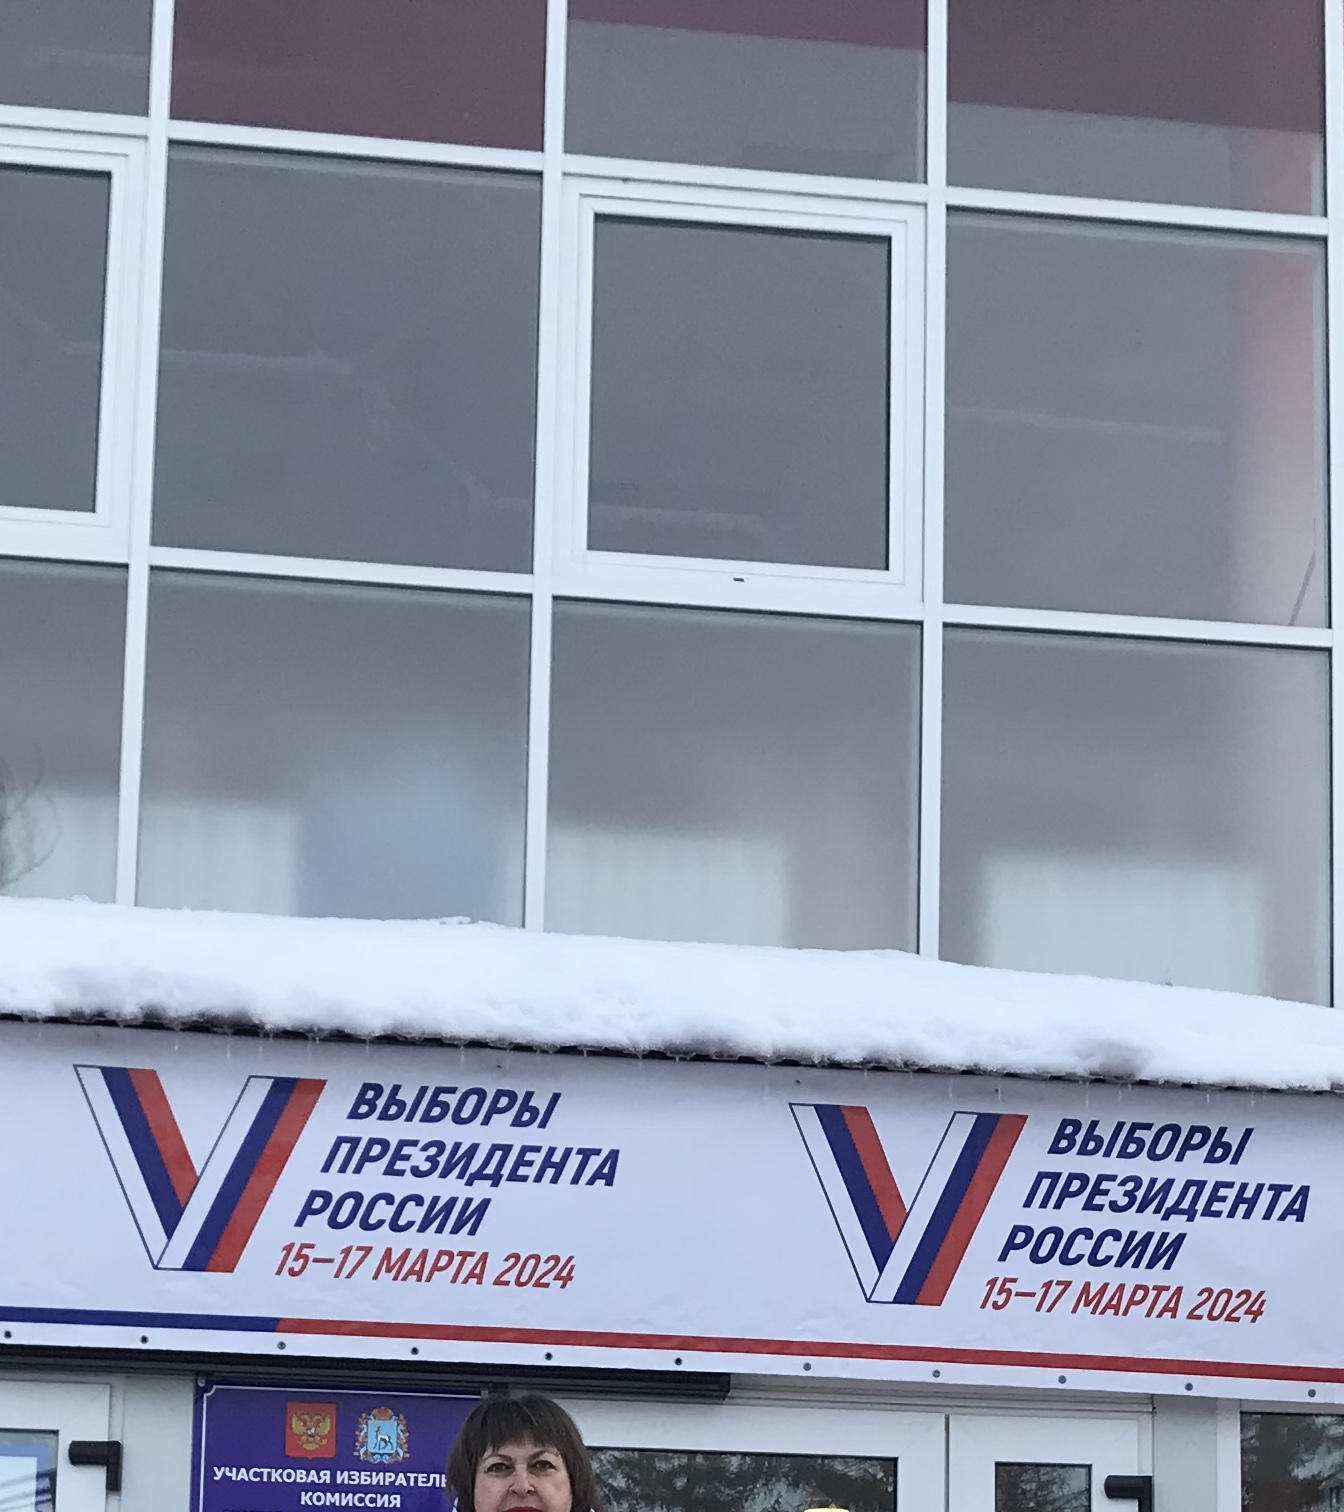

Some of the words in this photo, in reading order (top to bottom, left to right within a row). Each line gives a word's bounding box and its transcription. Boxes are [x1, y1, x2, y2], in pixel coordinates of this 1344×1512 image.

[346, 1082, 562, 1129] ВЫБОРЫ
[320, 1135, 620, 1187] ПРЕЗИДЕНТА
[1047, 1118, 1253, 1165] ВЫБОРЫ
[293, 1189, 491, 1237] РОССИИ
[1022, 1171, 1311, 1223] ПРЕЗИДЕНТА
[372, 1246, 490, 1286] МАРТА
[492, 1252, 576, 1289] 2024
[997, 1224, 1187, 1271] РОССИИ
[1071, 1281, 1183, 1319] МАРТА
[1186, 1286, 1266, 1324] 2024
[213, 1466, 331, 1485] УЧАСТКОВАЯ
[300, 1491, 401, 1508] КОМИССИЯ
